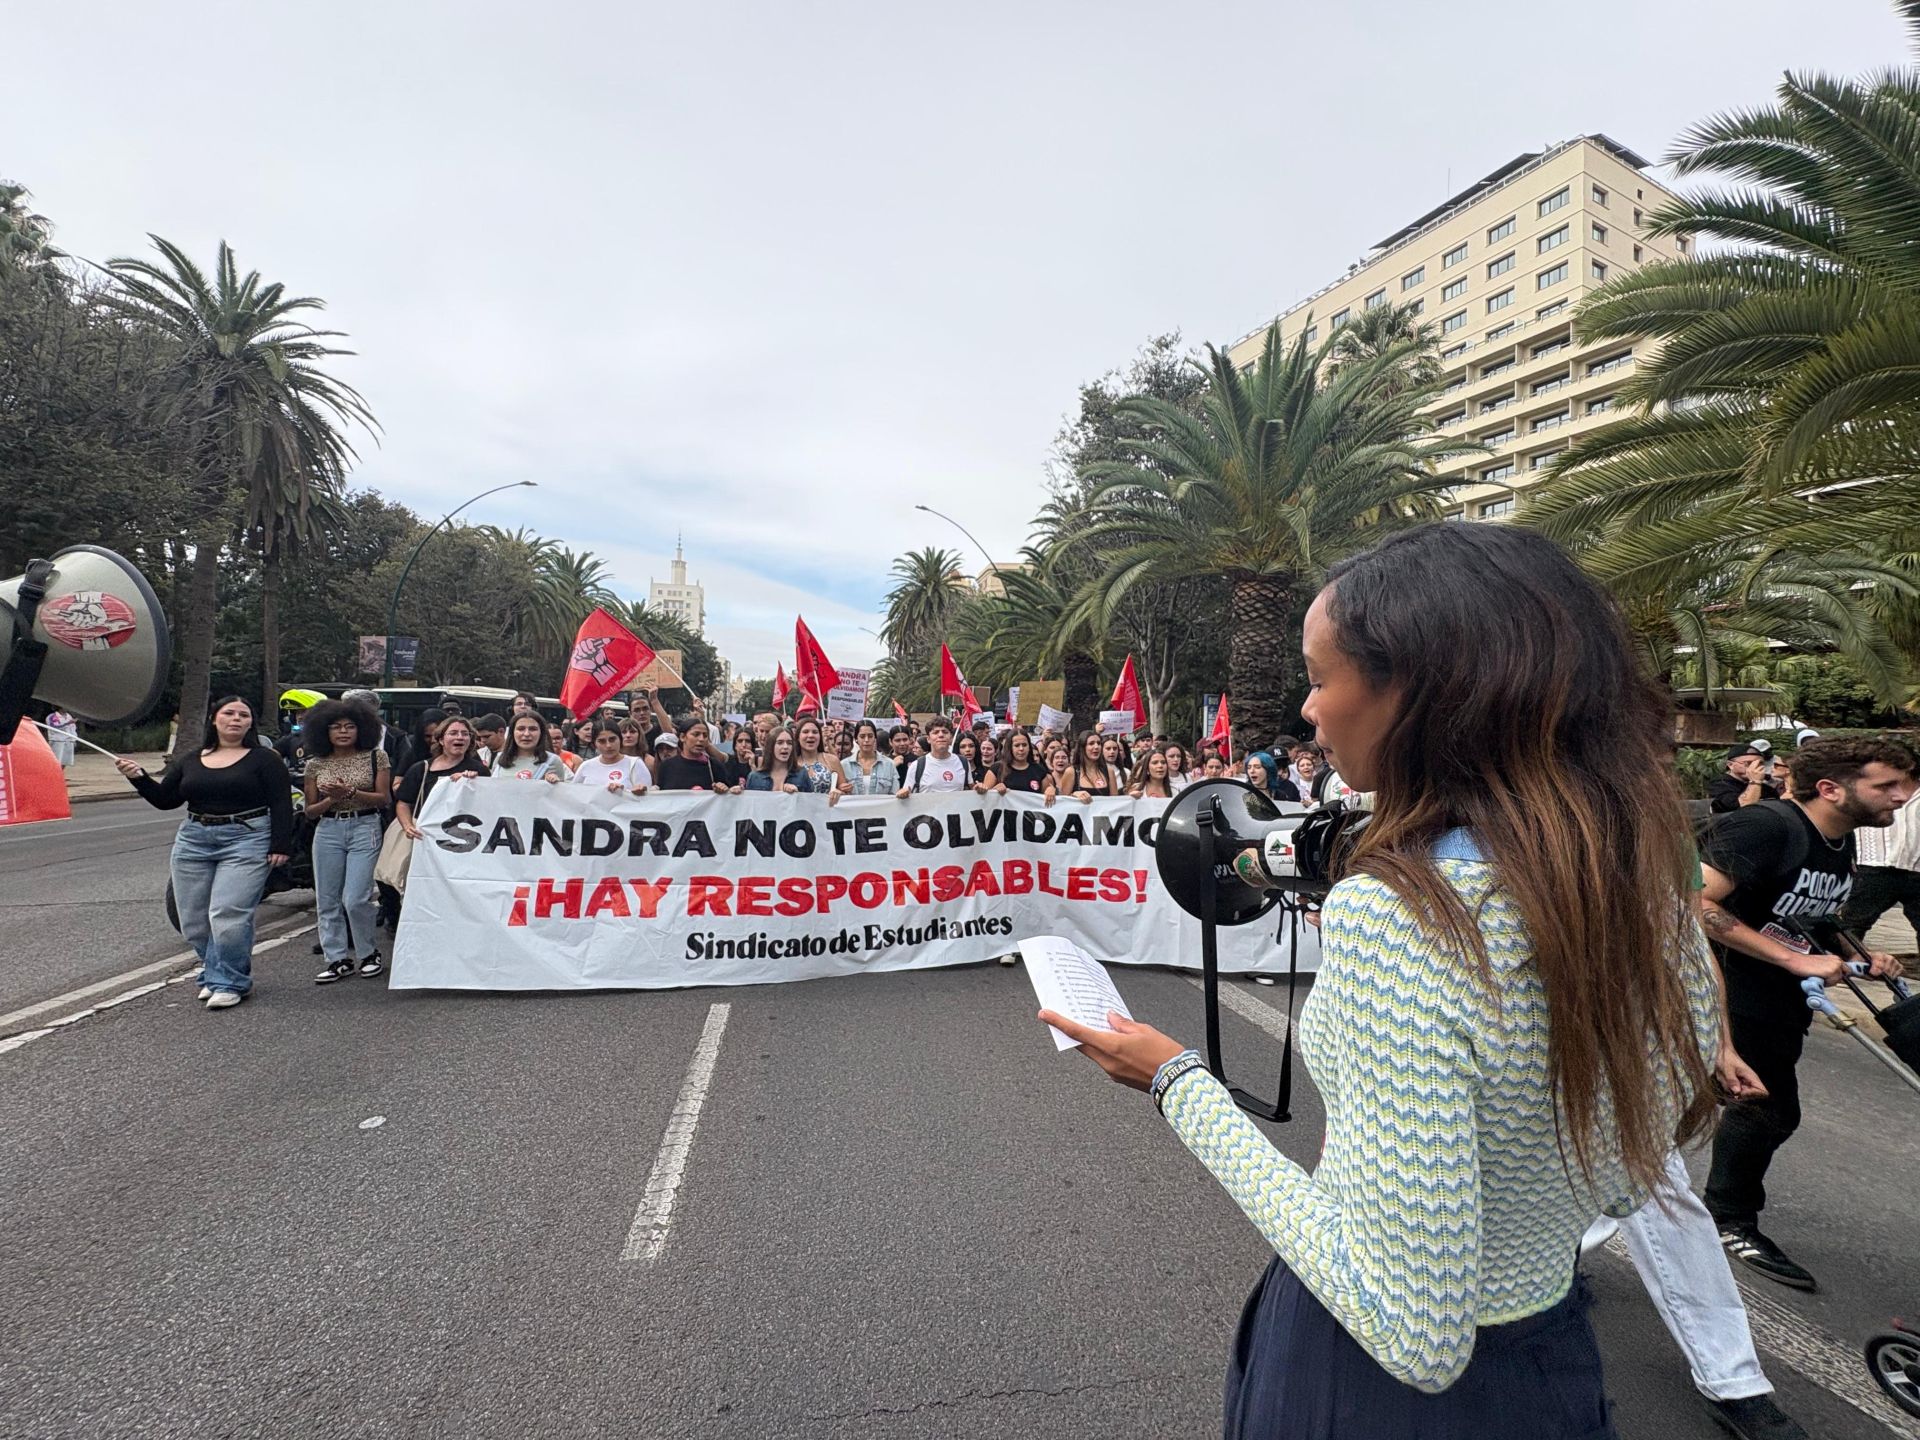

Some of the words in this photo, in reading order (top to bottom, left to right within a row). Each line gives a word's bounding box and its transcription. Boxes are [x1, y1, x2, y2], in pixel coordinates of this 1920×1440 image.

[435, 814, 717, 858] SANDRA
[734, 818, 816, 858] NO
[826, 818, 888, 856] TE
[508, 877, 673, 926] ¡HAY
[687, 859, 1148, 916] RESPONSABLES!
[685, 931, 826, 960] Sindicato
[829, 928, 860, 955] de
[864, 914, 1013, 950] Estudiantes
[1157, 1075, 1169, 1093] STOP
[1167, 1058, 1198, 1080] STEALING
